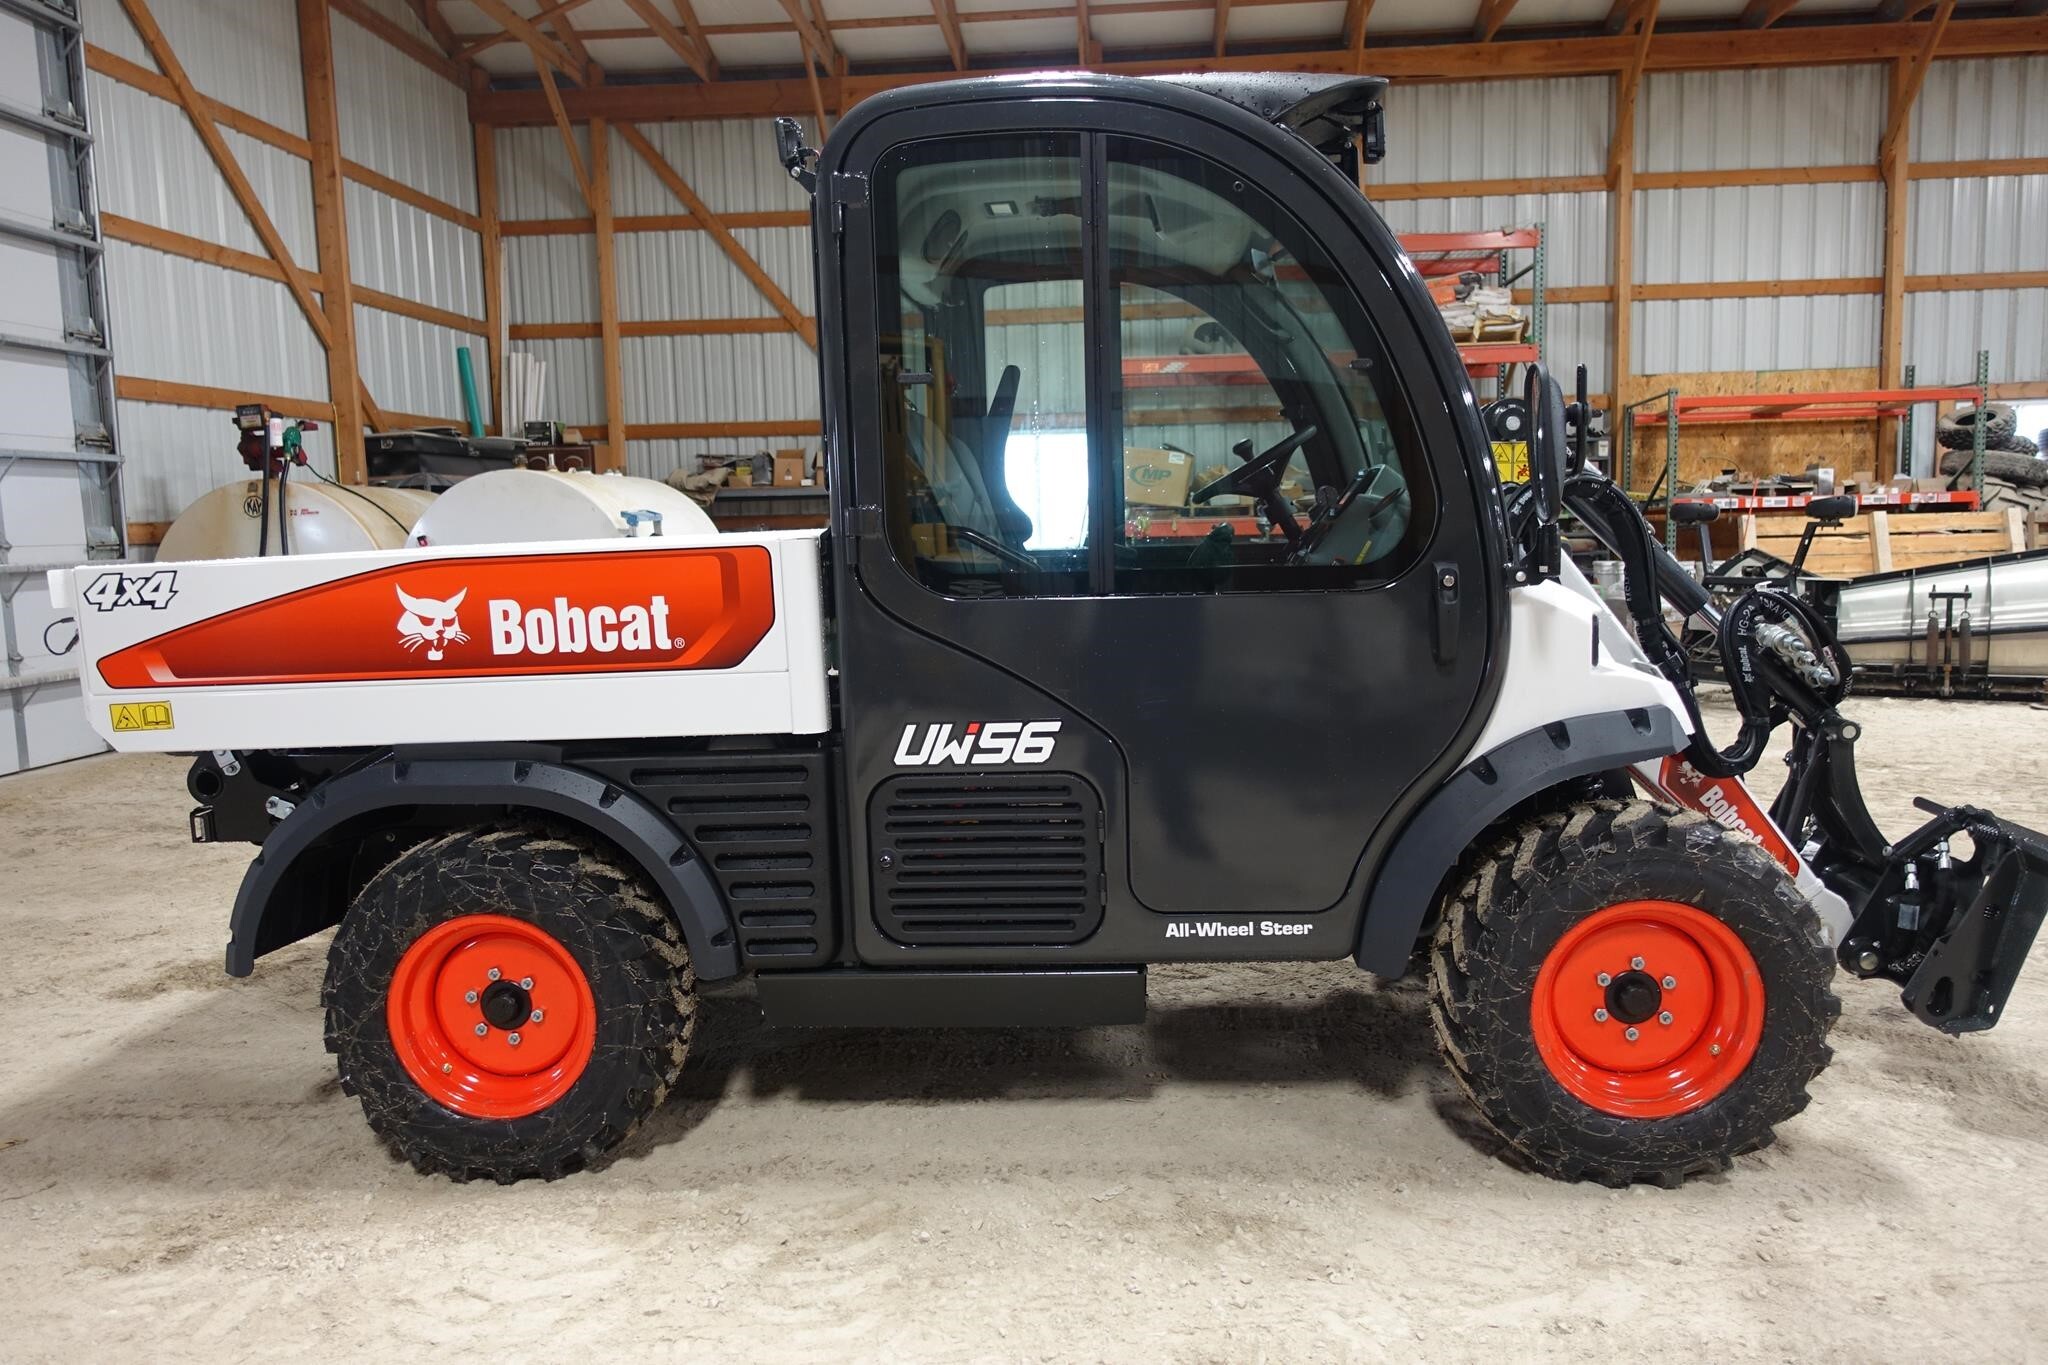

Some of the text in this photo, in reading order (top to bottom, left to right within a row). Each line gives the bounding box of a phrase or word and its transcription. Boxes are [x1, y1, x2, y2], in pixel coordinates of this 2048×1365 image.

[83, 570, 179, 612] 4x4
[893, 721, 1062, 765] UW56
[1165, 921, 1313, 938] All-Wheel Steer
